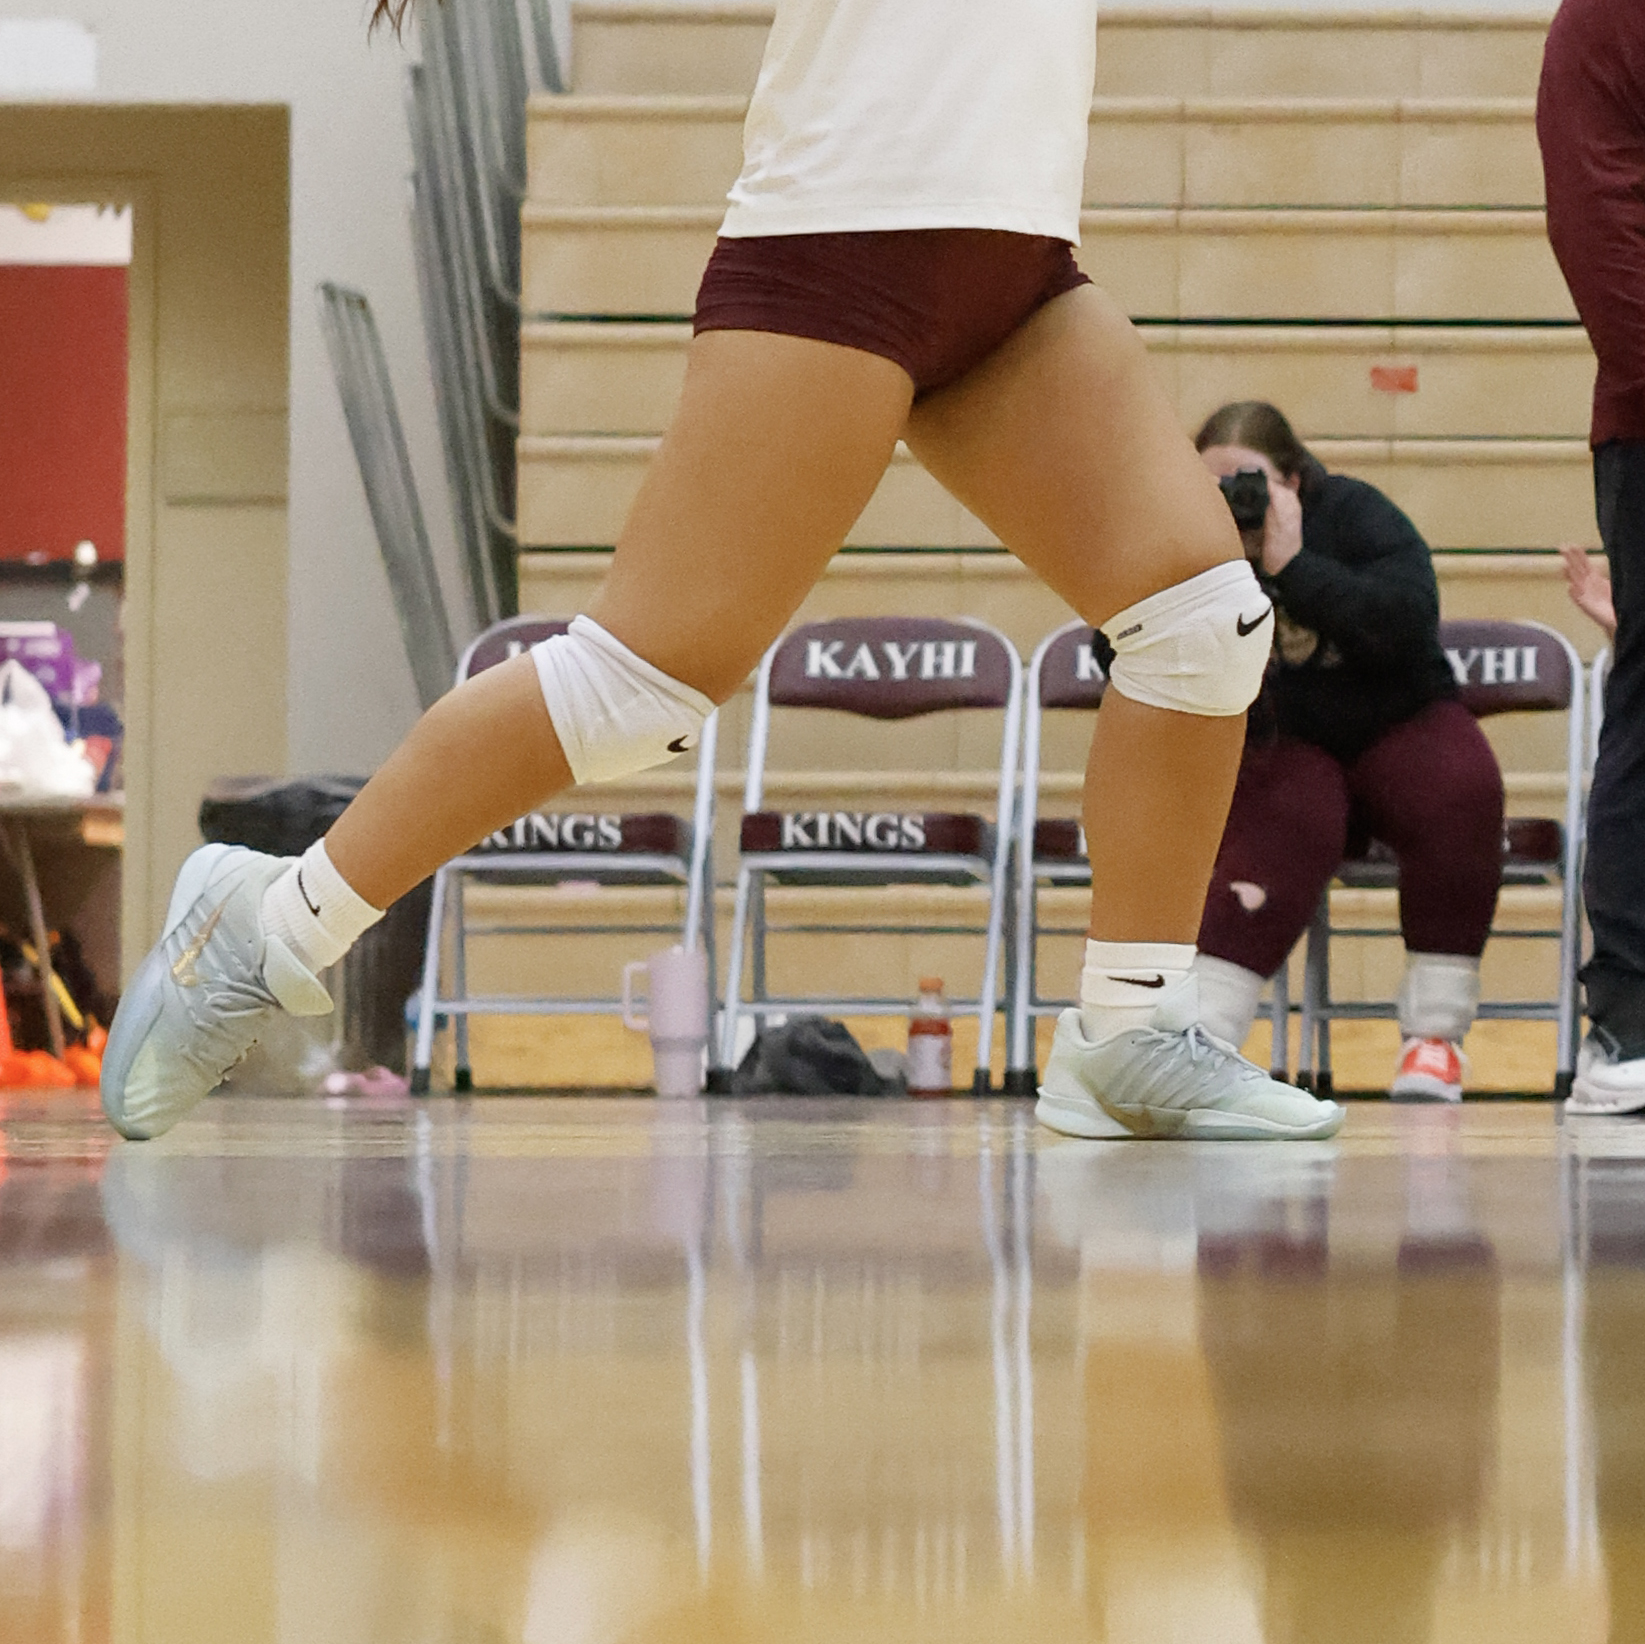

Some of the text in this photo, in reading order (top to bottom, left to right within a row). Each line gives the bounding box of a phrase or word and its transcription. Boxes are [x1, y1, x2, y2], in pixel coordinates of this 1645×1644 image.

[806, 639, 977, 681] KAYHI
[1445, 645, 1538, 685] YHI
[782, 812, 926, 849] KINGS
